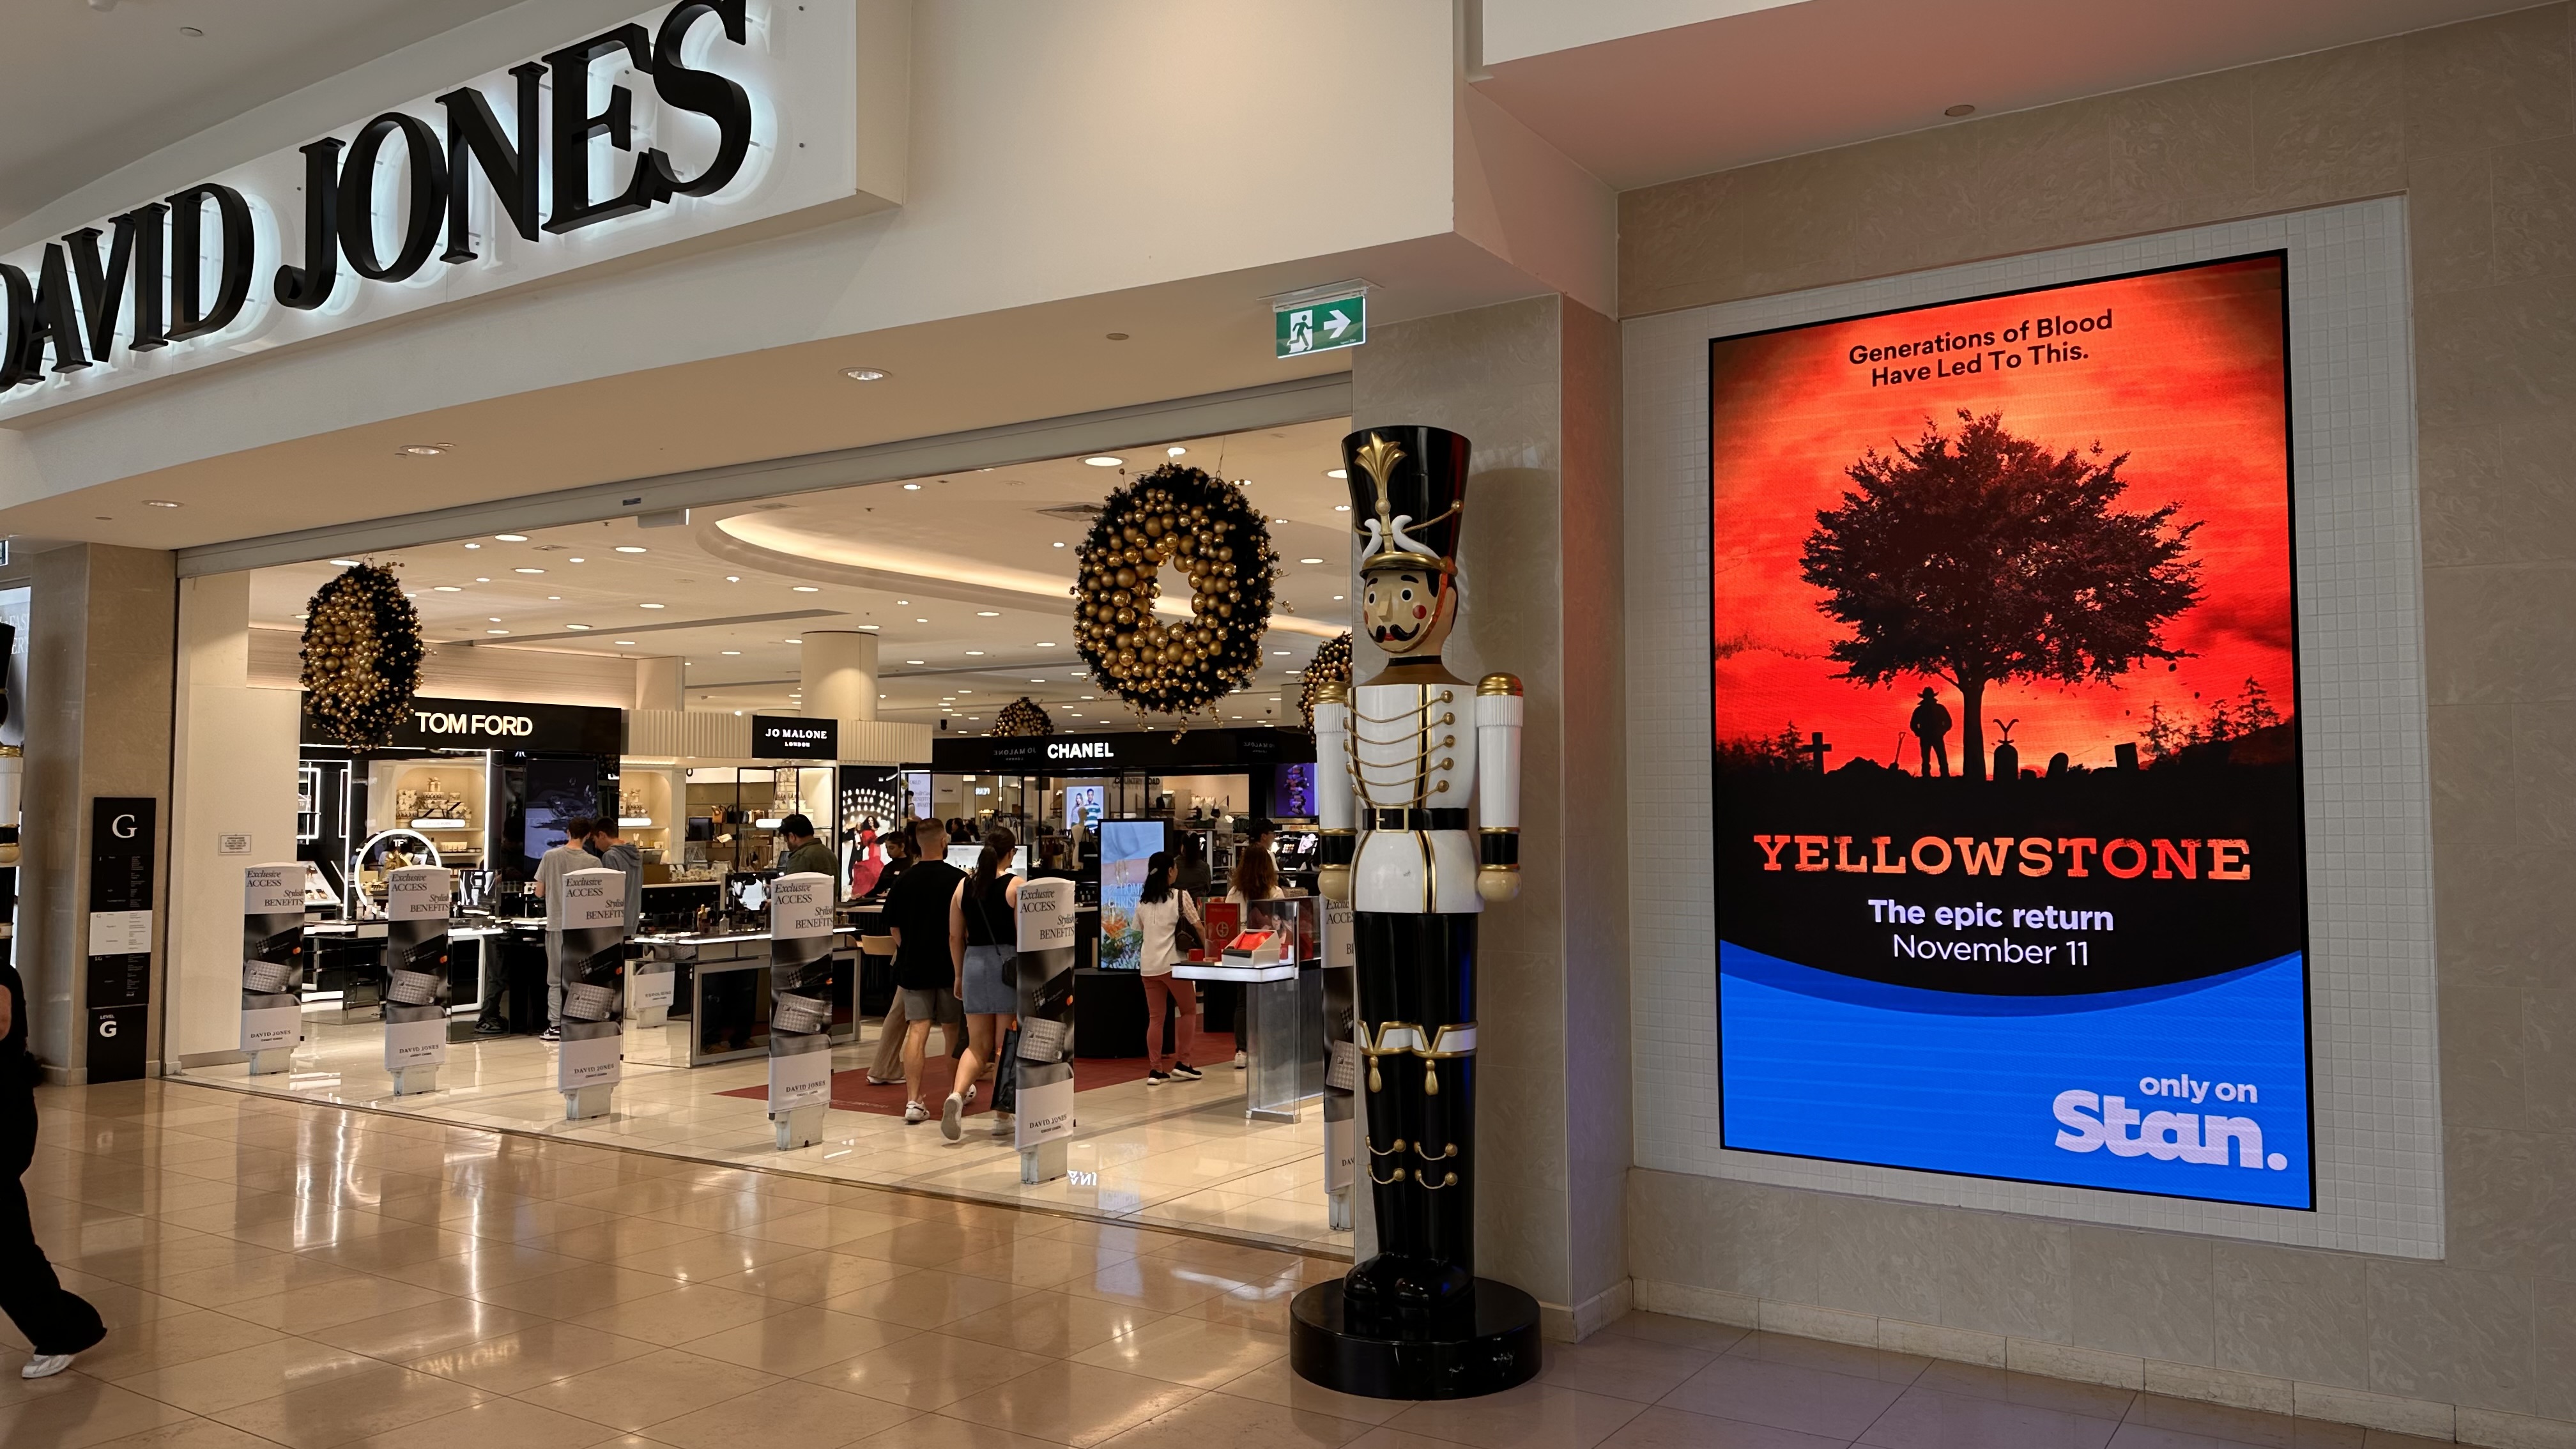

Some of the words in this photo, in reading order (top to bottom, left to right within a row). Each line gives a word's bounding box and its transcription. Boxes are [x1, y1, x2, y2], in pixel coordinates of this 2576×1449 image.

[274, 0, 752, 310] JONES
[1849, 332, 1995, 364] Generations
[2003, 319, 2030, 343] of
[2037, 309, 2112, 338] Blood
[1872, 364, 1931, 387] Have
[1938, 353, 1981, 378] Led
[1988, 350, 2021, 370] To
[2028, 342, 2089, 365] This.
[415, 712, 467, 733] TOM
[471, 715, 533, 736] FORD
[765, 728, 780, 737] JO
[783, 729, 827, 739] MALONE
[1047, 742, 1114, 758] CHANEL
[112, 814, 138, 838] G
[1754, 835, 2251, 880] YELLOWSTONE
[392, 873, 427, 882] Exclusive
[566, 877, 602, 887] Exclusive
[283, 889, 304, 898] Stylish
[392, 883, 427, 892] ACCESS
[565, 887, 603, 898] ACCESS
[775, 883, 811, 893] Exclusive
[774, 894, 812, 905] ACCESS
[1020, 889, 1055, 900] Exclusive
[264, 898, 304, 907] BENEFITS
[410, 903, 449, 912] BENEFITS
[1020, 901, 1055, 914] ACCESS
[1108, 896, 1137, 908] CHRIST
[1326, 912, 1353, 924] ACCE
[1868, 900, 1924, 924] The
[1935, 901, 2003, 931] epic
[2013, 905, 2113, 931] return
[1039, 926, 1074, 940] BENEFITS
[1893, 934, 2056, 965] November
[2066, 940, 2088, 965] 11
[100, 1021, 117, 1038] G
[786, 1084, 806, 1092] DAVID
[808, 1080, 825, 1089] JONES
[2139, 1074, 2210, 1103] only
[2215, 1082, 2258, 1103] on
[1029, 1119, 1050, 1128] DAVID
[1051, 1114, 1067, 1124] JONES
[2053, 1089, 2288, 1170] Stan.
